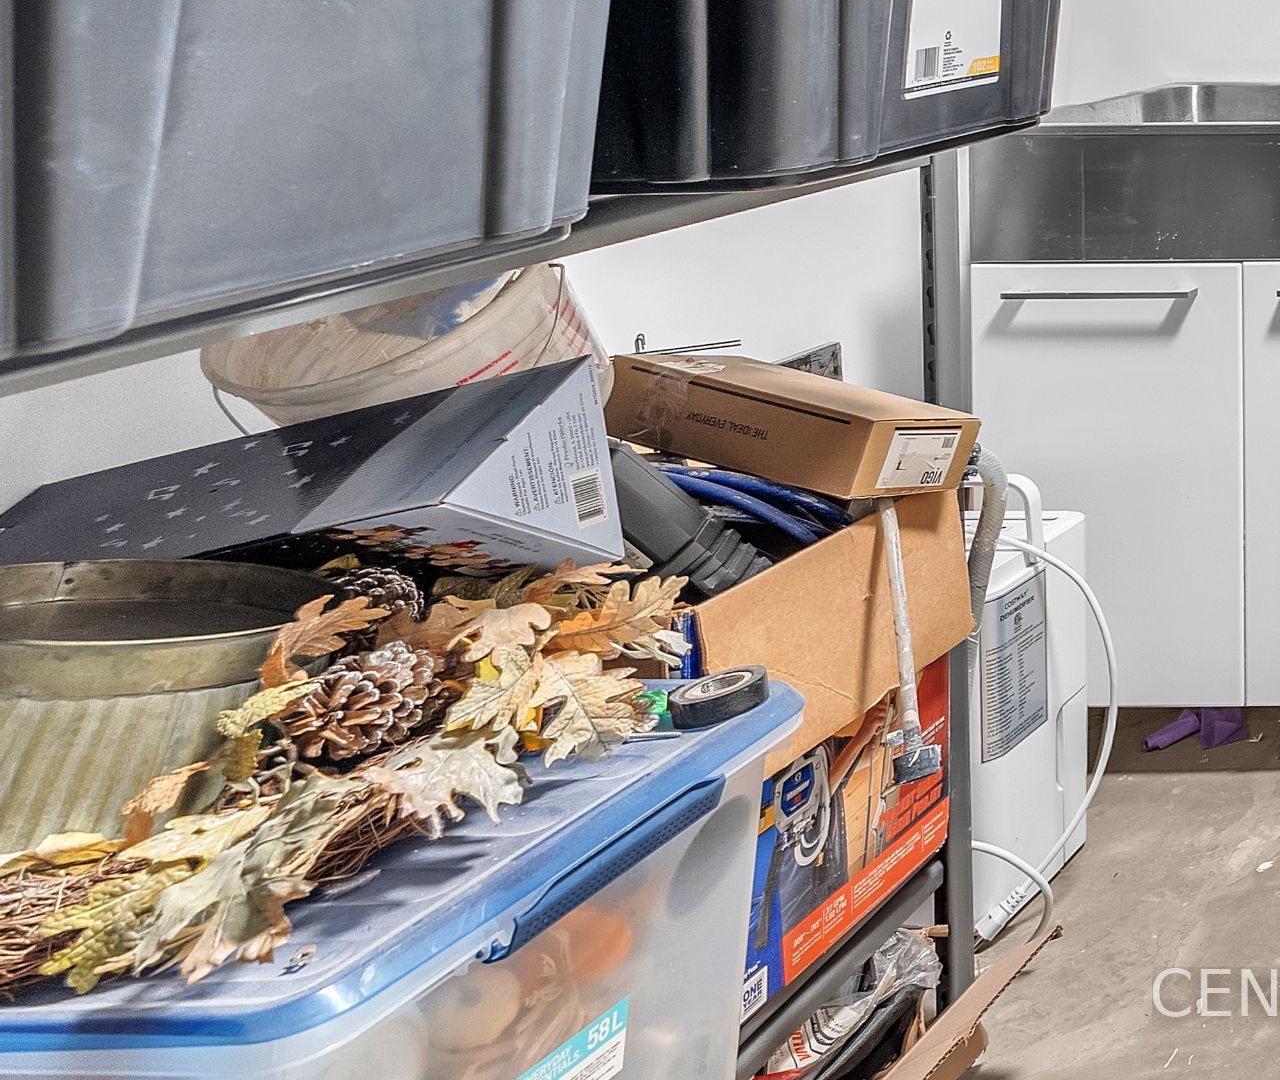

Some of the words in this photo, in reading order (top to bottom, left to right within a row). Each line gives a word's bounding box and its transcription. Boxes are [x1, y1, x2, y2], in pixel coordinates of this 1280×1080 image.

[686, 411, 726, 430] EVERYDAY
[728, 422, 751, 438] IDEAL
[752, 428, 768, 441] THE
[1000, 595, 1035, 622] DEHUMIDIFIER
[1004, 589, 1029, 611] COSTWAY
[743, 978, 764, 1005] ONE
